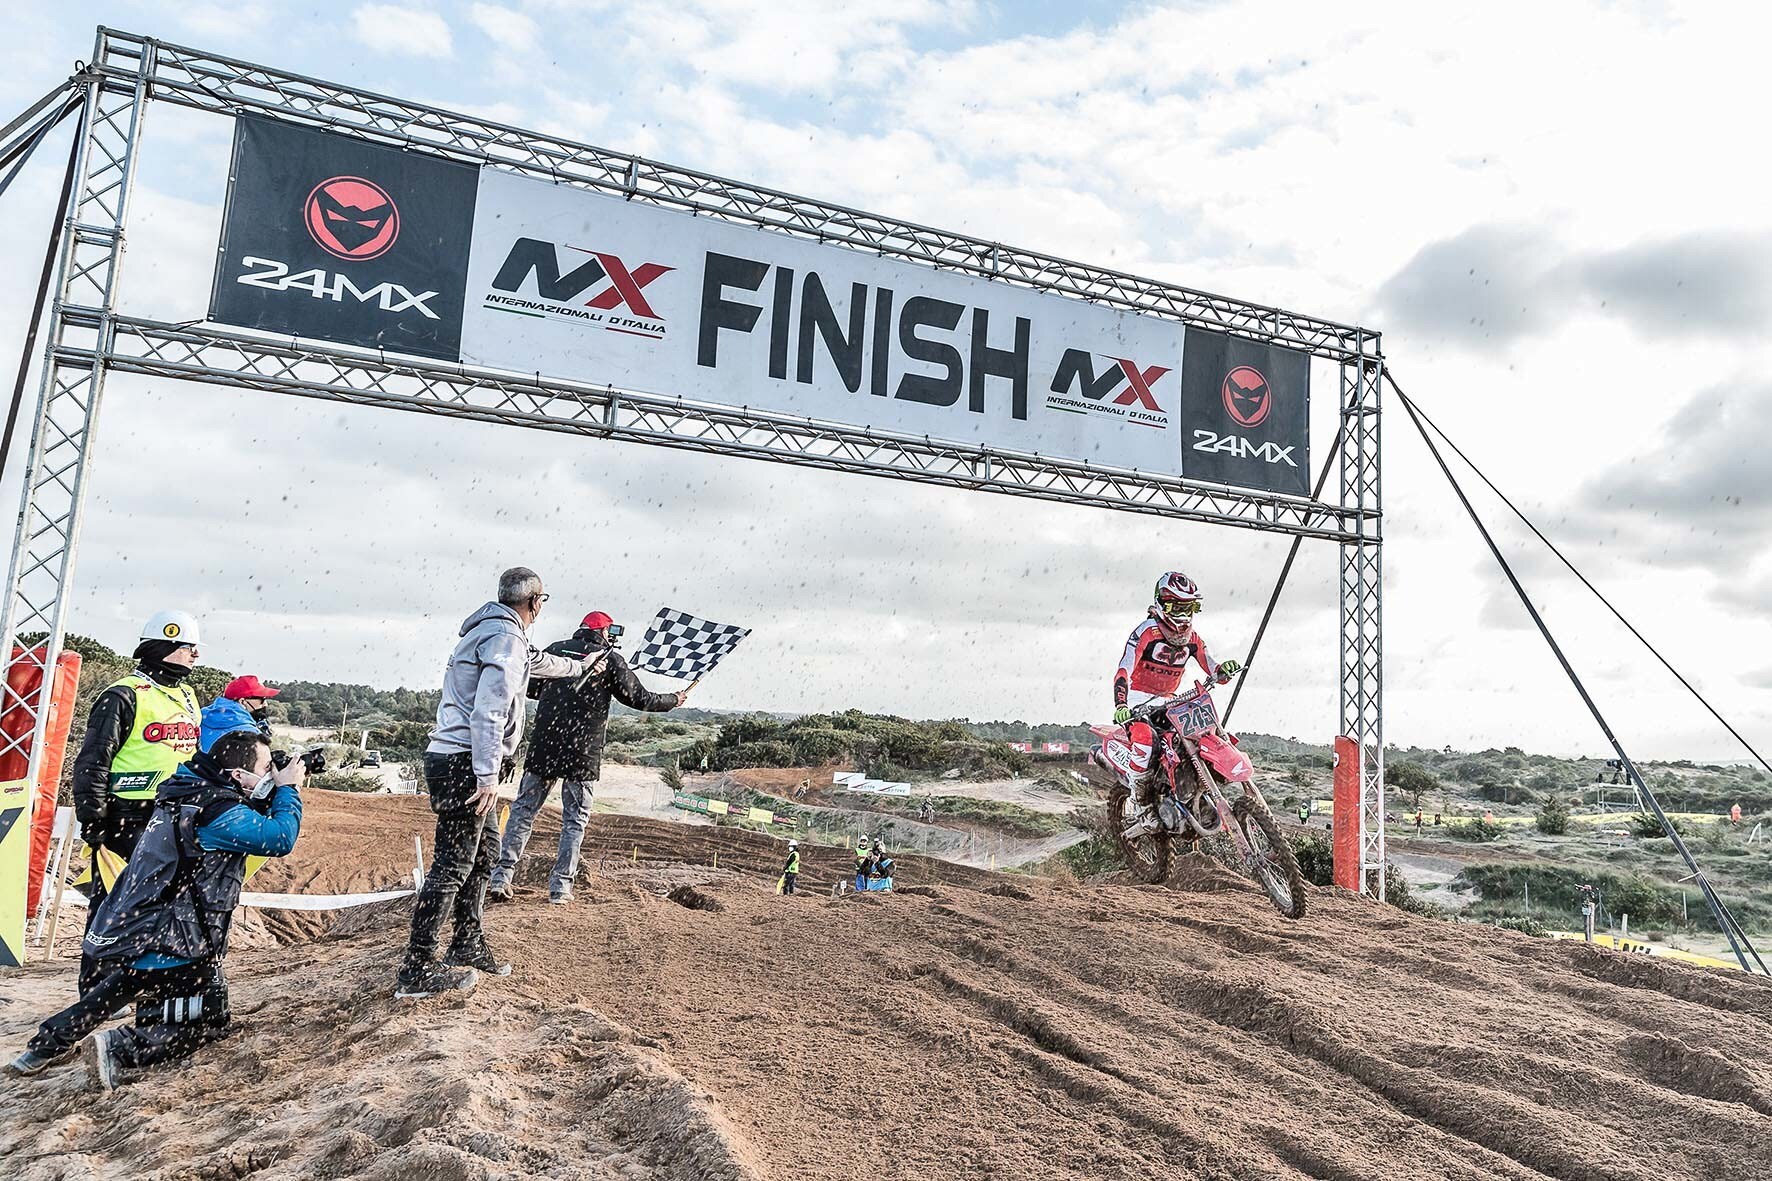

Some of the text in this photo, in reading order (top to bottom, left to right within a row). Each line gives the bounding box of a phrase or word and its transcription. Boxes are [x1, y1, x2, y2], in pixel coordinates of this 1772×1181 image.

[237, 255, 441, 320] 24MX
[491, 237, 677, 320] MX
[485, 294, 666, 333] INTERNAZIONALI D'ITALIA
[697, 250, 1031, 421] FINISH
[1047, 396, 1125, 415] INTERNAZIONALI
[1193, 429, 1298, 467] 24MX
